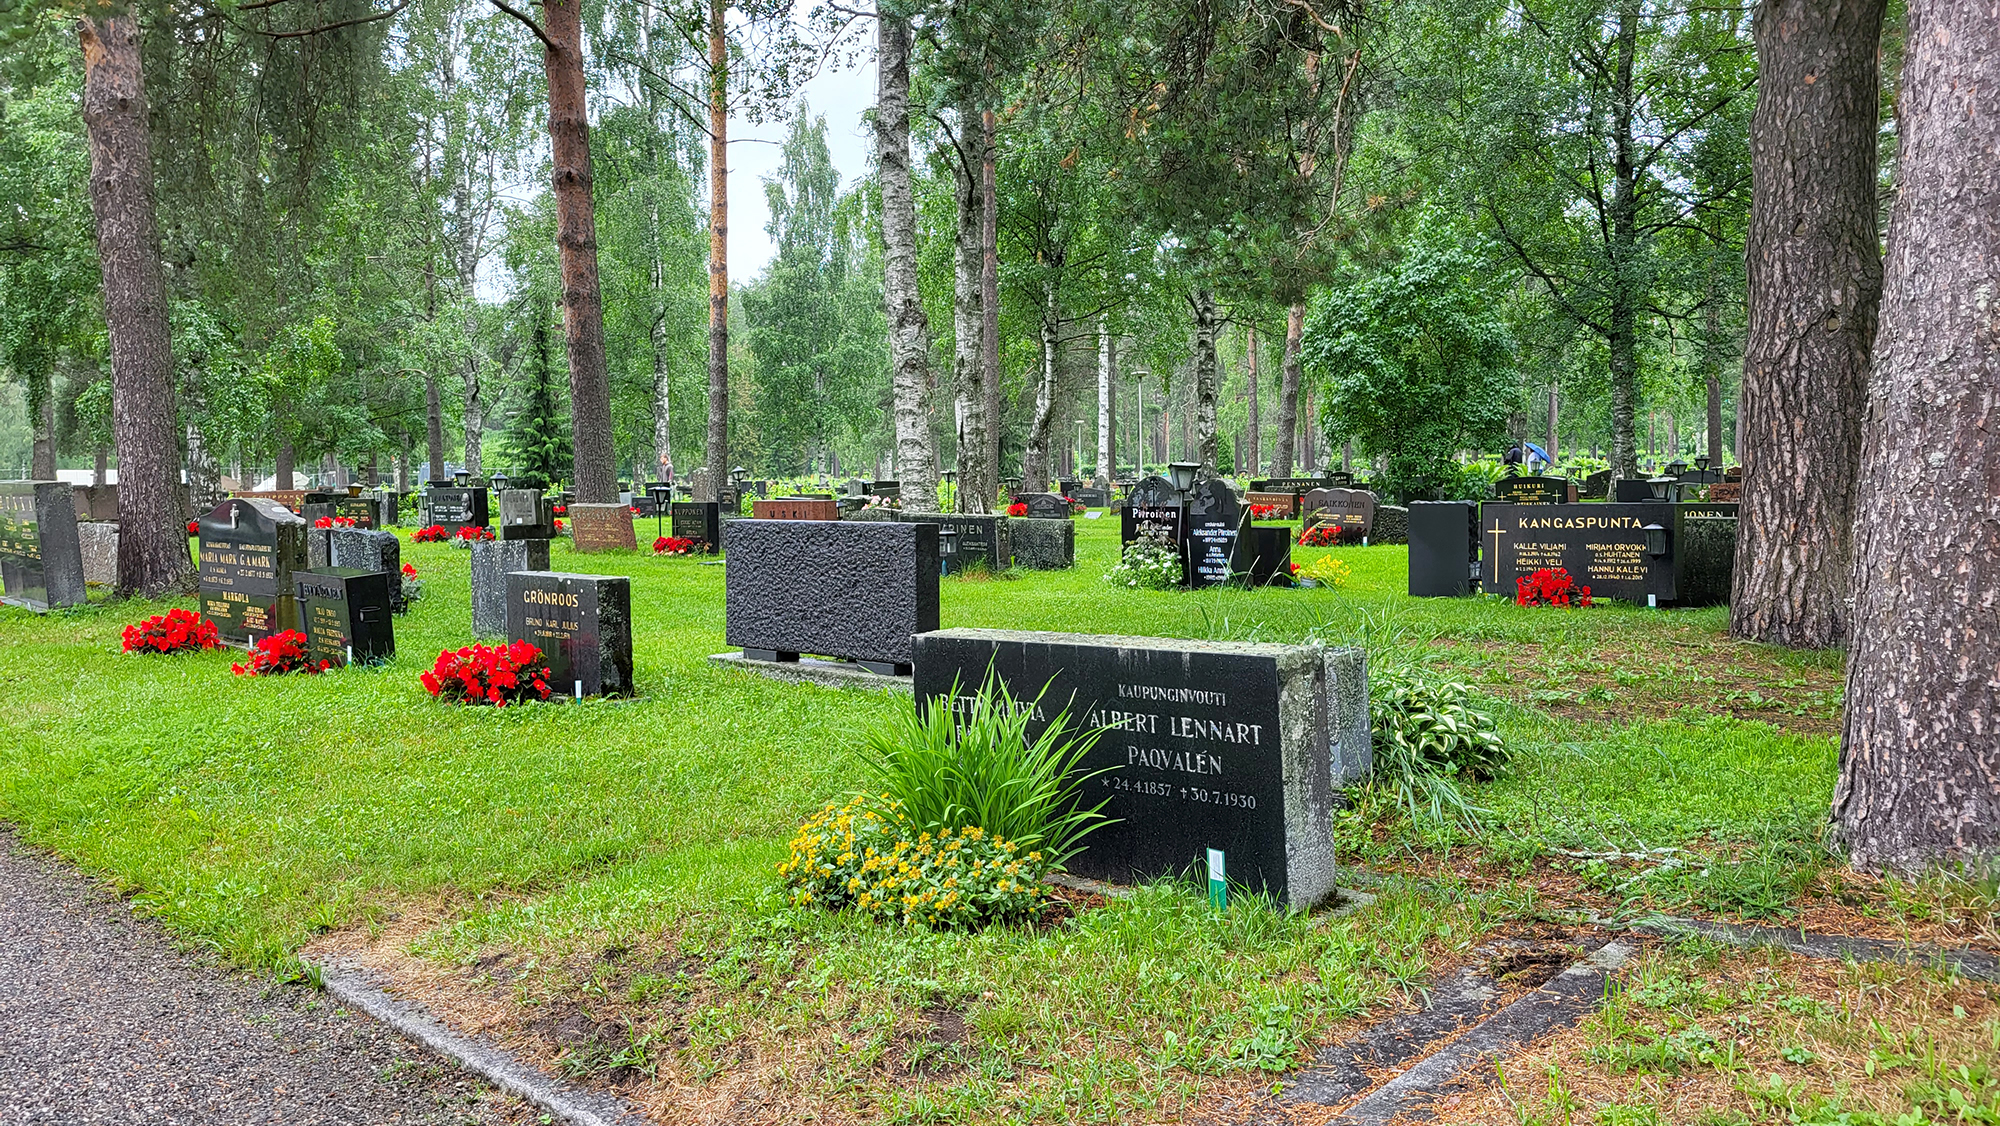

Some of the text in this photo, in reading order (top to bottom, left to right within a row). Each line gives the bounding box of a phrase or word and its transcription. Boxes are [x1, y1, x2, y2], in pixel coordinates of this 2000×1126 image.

[1318, 500, 1365, 509] SAIKKONEN
[770, 510, 807, 519] USKI
[1519, 517, 1642, 529] KANGASPUNTA
[1513, 542, 1567, 551] KALLE VILJAMI
[1585, 543, 1612, 551] MIRJAM
[200, 552, 219, 563] MARIA
[220, 553, 238, 565] MARK
[252, 555, 271, 568] MARK
[1516, 558, 1542, 566] HEIKKI
[1587, 565, 1648, 574] HANNU KALEVI
[523, 589, 579, 608] GRÖNROOS
[525, 617, 579, 631] BRUNO KARL JULIUS
[1118, 684, 1227, 707] KAUPUNGINVOUTI
[939, 693, 983, 715] BETT
[1090, 709, 1263, 745] ALBERT LENNART
[1128, 745, 1223, 775] PAQVALÉN
